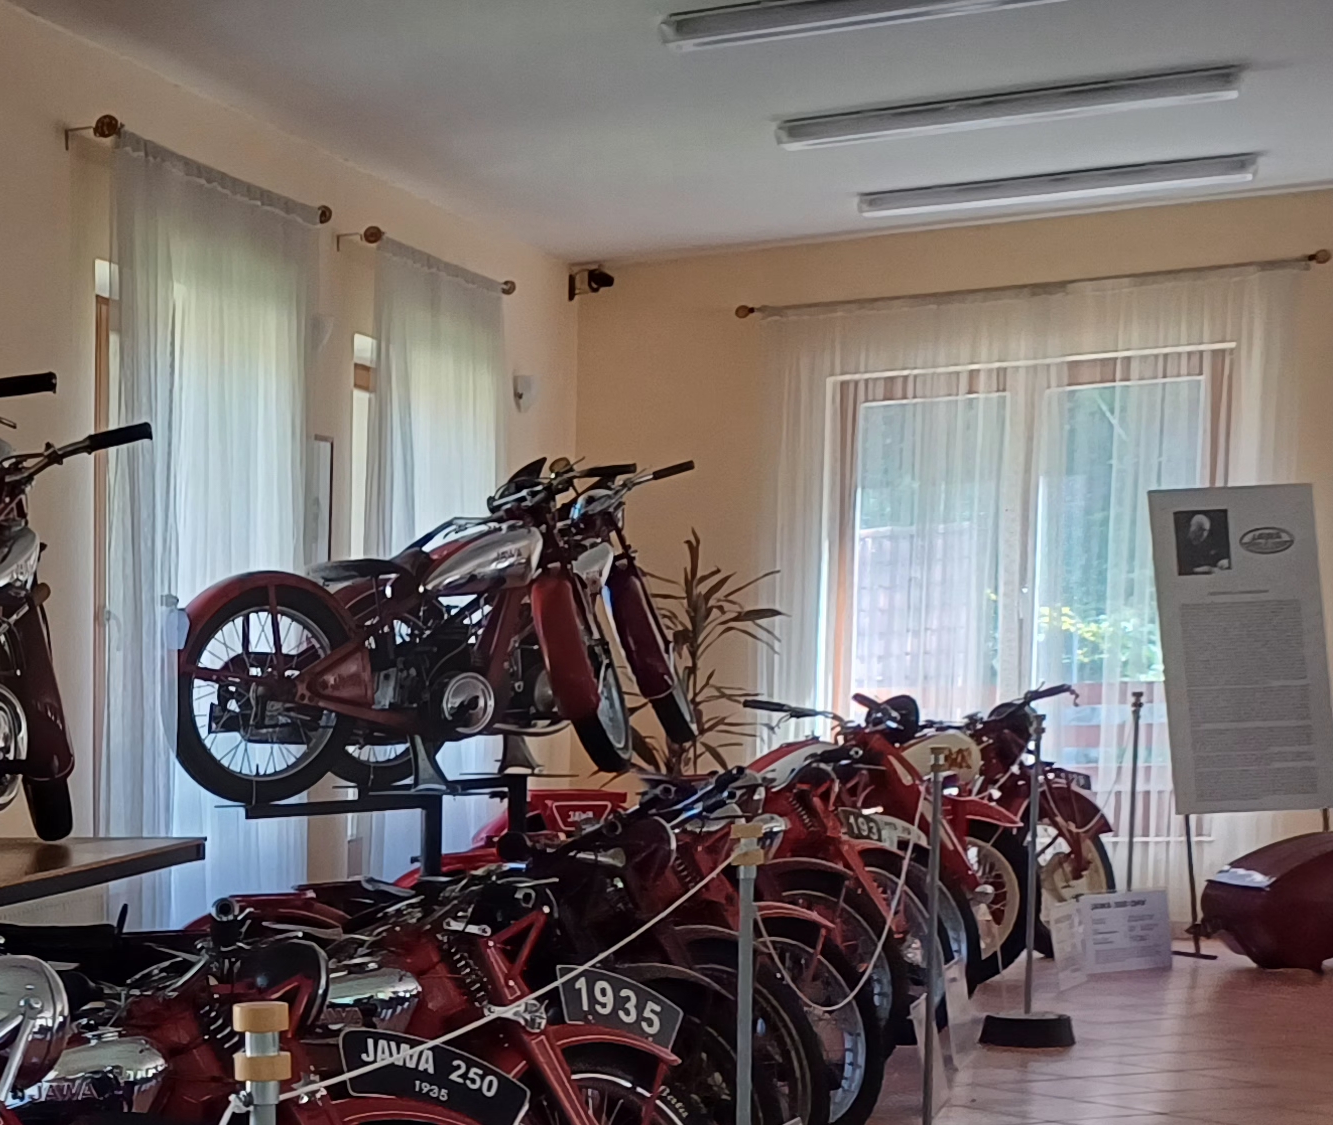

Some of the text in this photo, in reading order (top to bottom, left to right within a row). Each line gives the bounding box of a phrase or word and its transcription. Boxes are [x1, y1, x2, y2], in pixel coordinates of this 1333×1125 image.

[848, 814, 879, 840] 193
[575, 976, 662, 1035] 1935
[361, 1038, 499, 1097] JAWA 250
[414, 1080, 449, 1101] 1935
